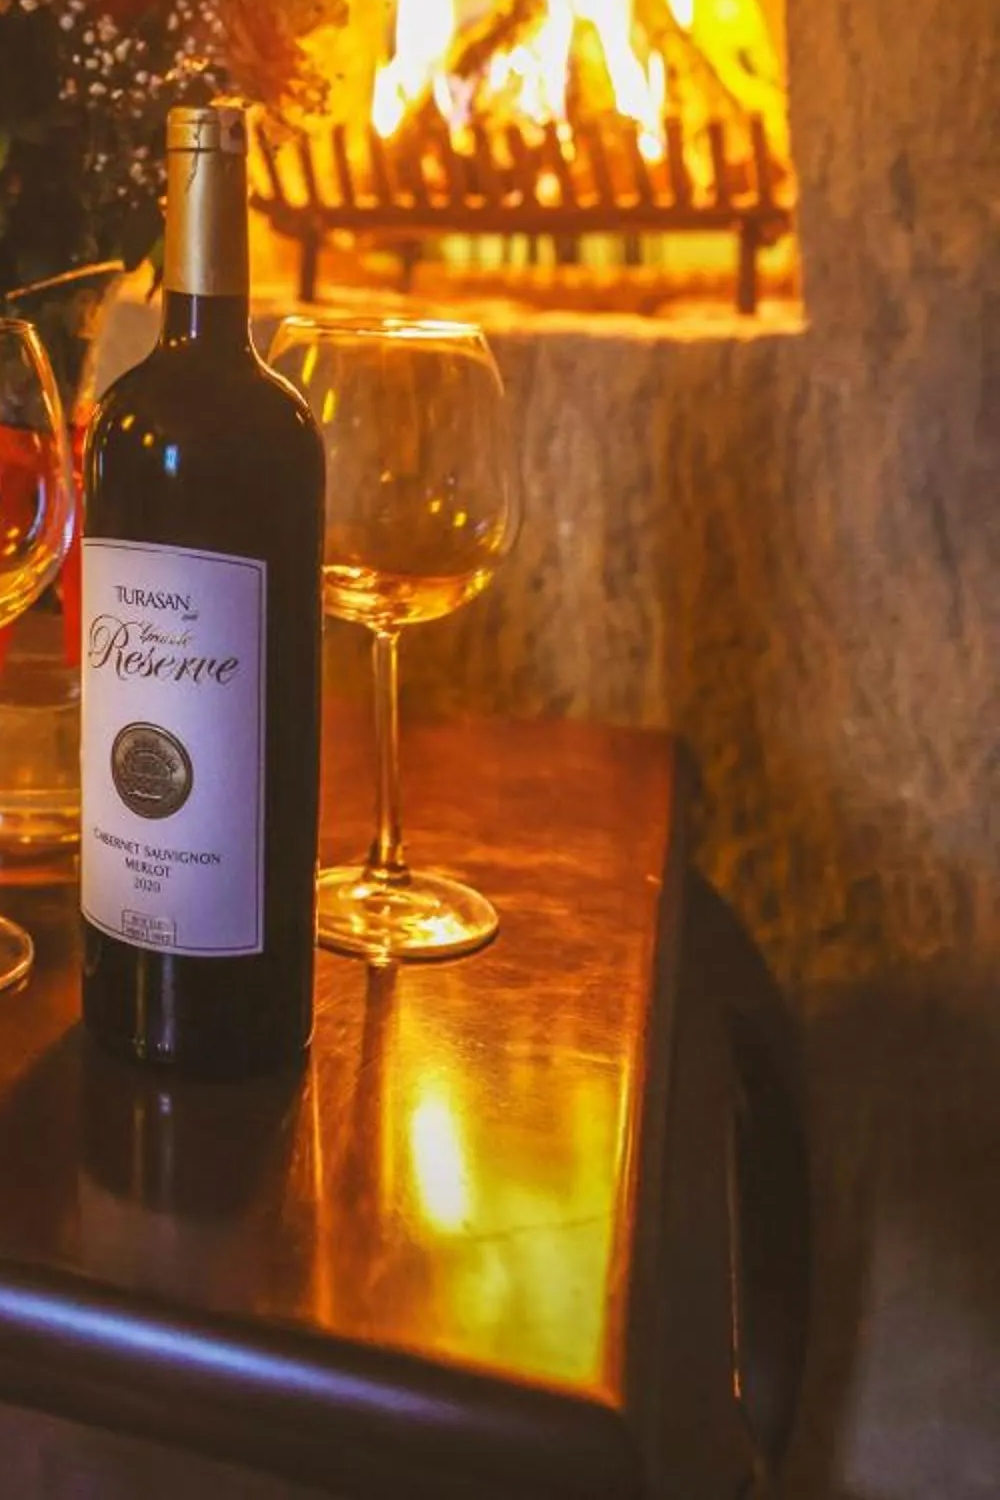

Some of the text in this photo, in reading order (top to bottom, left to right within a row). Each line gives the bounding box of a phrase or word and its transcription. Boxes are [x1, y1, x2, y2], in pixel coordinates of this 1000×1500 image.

[114, 585, 191, 611] TURASAN
[93, 827, 222, 865] CABERNET SAUVIGNON
[125, 857, 171, 878] MERLOT
